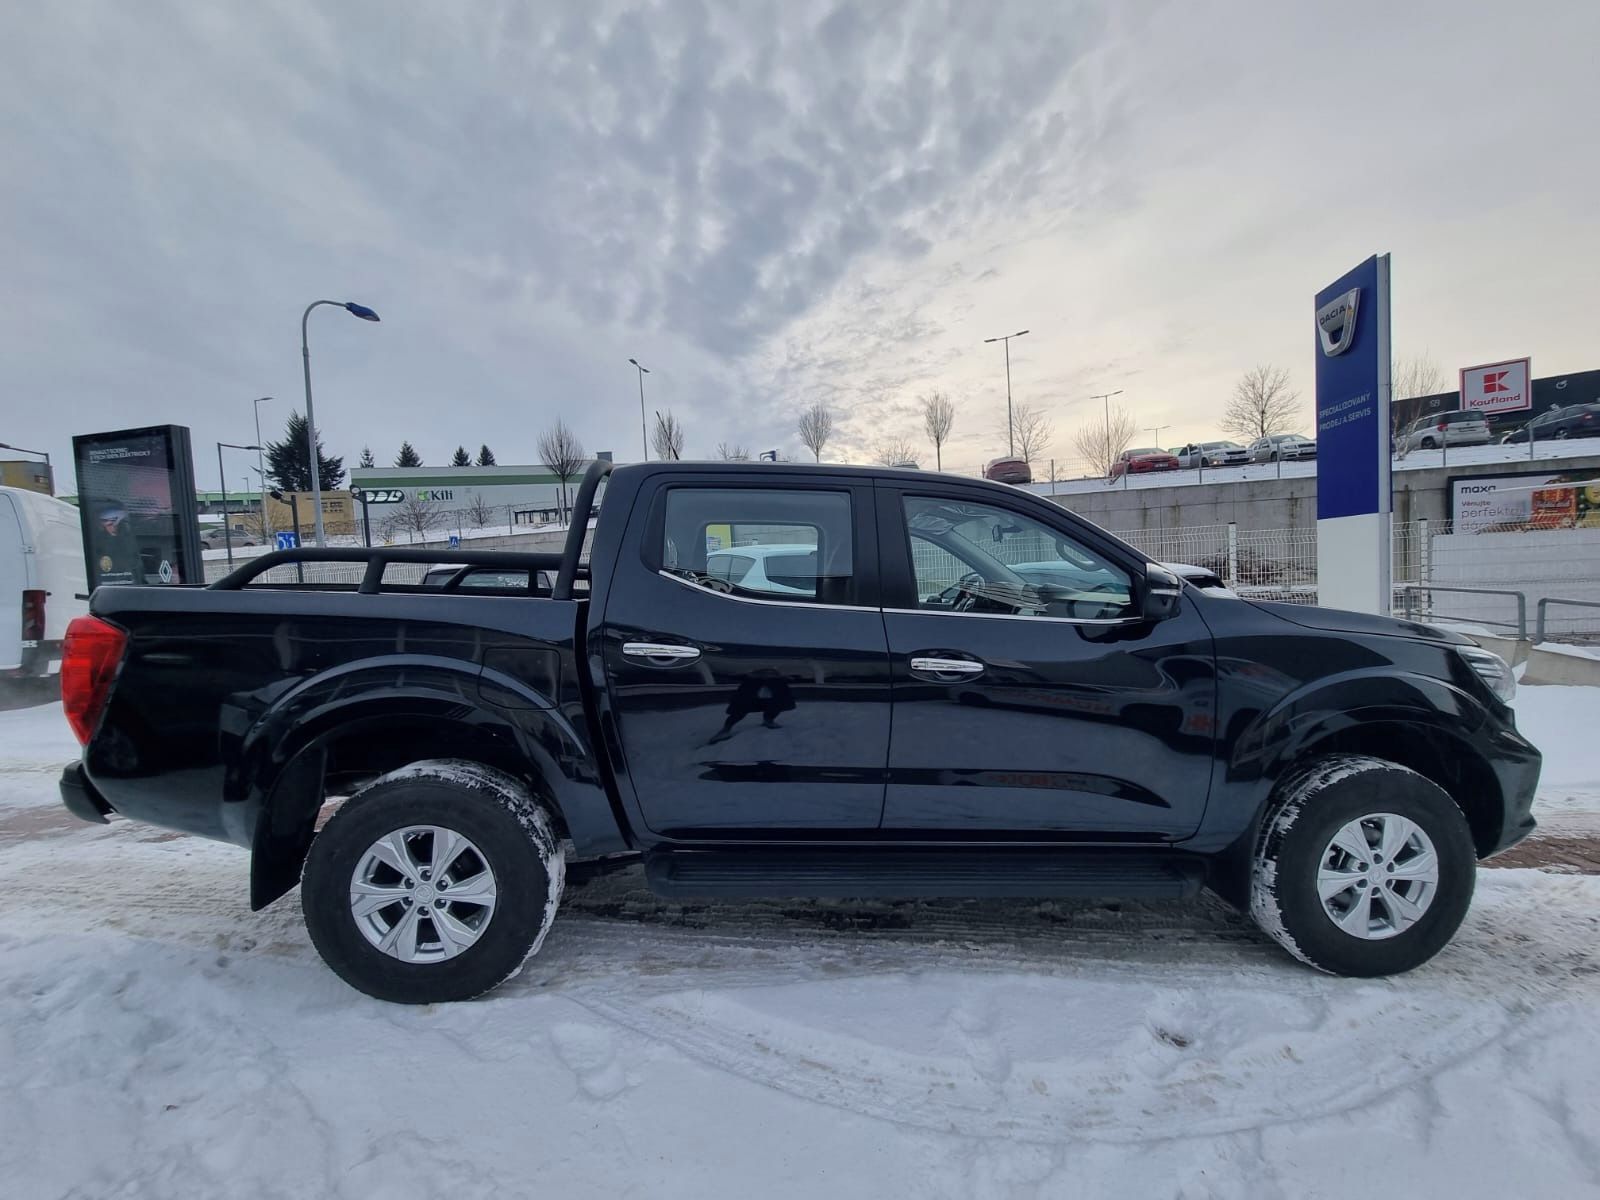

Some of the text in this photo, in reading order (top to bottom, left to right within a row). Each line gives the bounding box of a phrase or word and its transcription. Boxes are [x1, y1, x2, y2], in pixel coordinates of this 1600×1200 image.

[1319, 304, 1346, 326] DACIA
[1470, 393, 1521, 407] Kaufland
[431, 490, 453, 501] Kili
